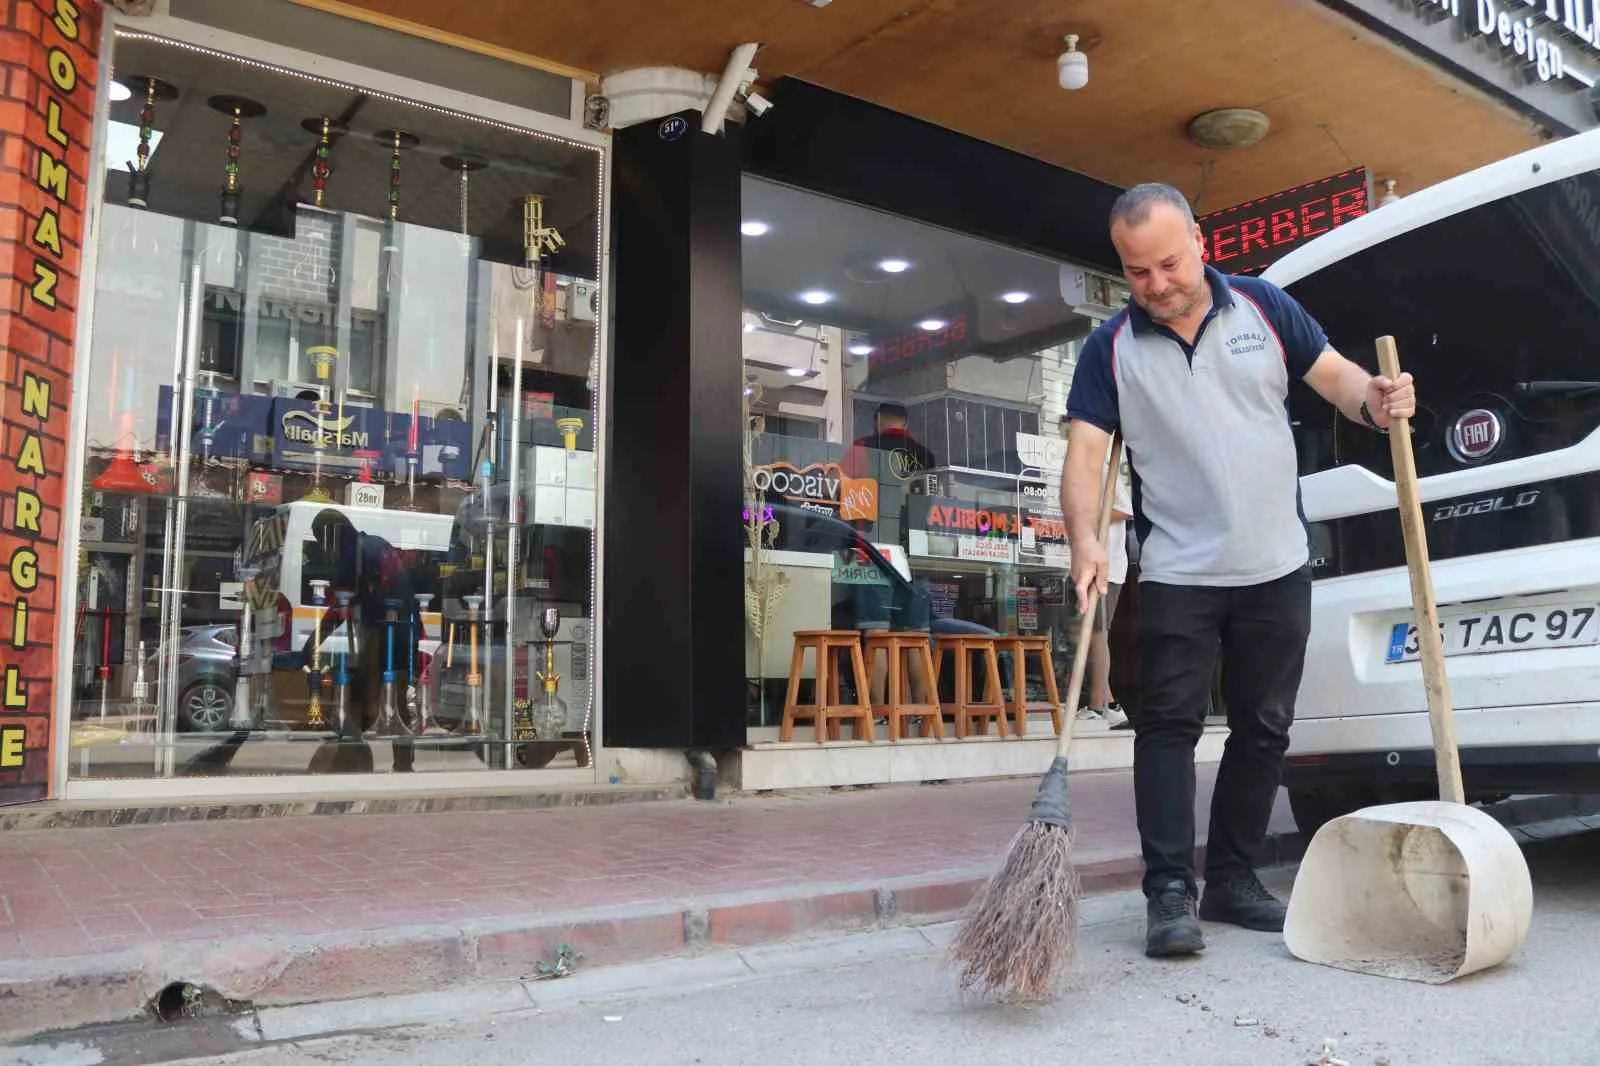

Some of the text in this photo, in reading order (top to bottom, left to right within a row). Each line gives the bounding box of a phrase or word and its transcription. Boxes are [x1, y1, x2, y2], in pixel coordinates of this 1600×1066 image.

[1476, 0, 1564, 82] Design
[31, 0, 79, 311] SOLMAZ
[1463, 420, 1490, 445] FIAT
[1433, 490, 1541, 521] DOBLO
[1459, 612, 1536, 648] TAC
[1546, 607, 1596, 641] 97
